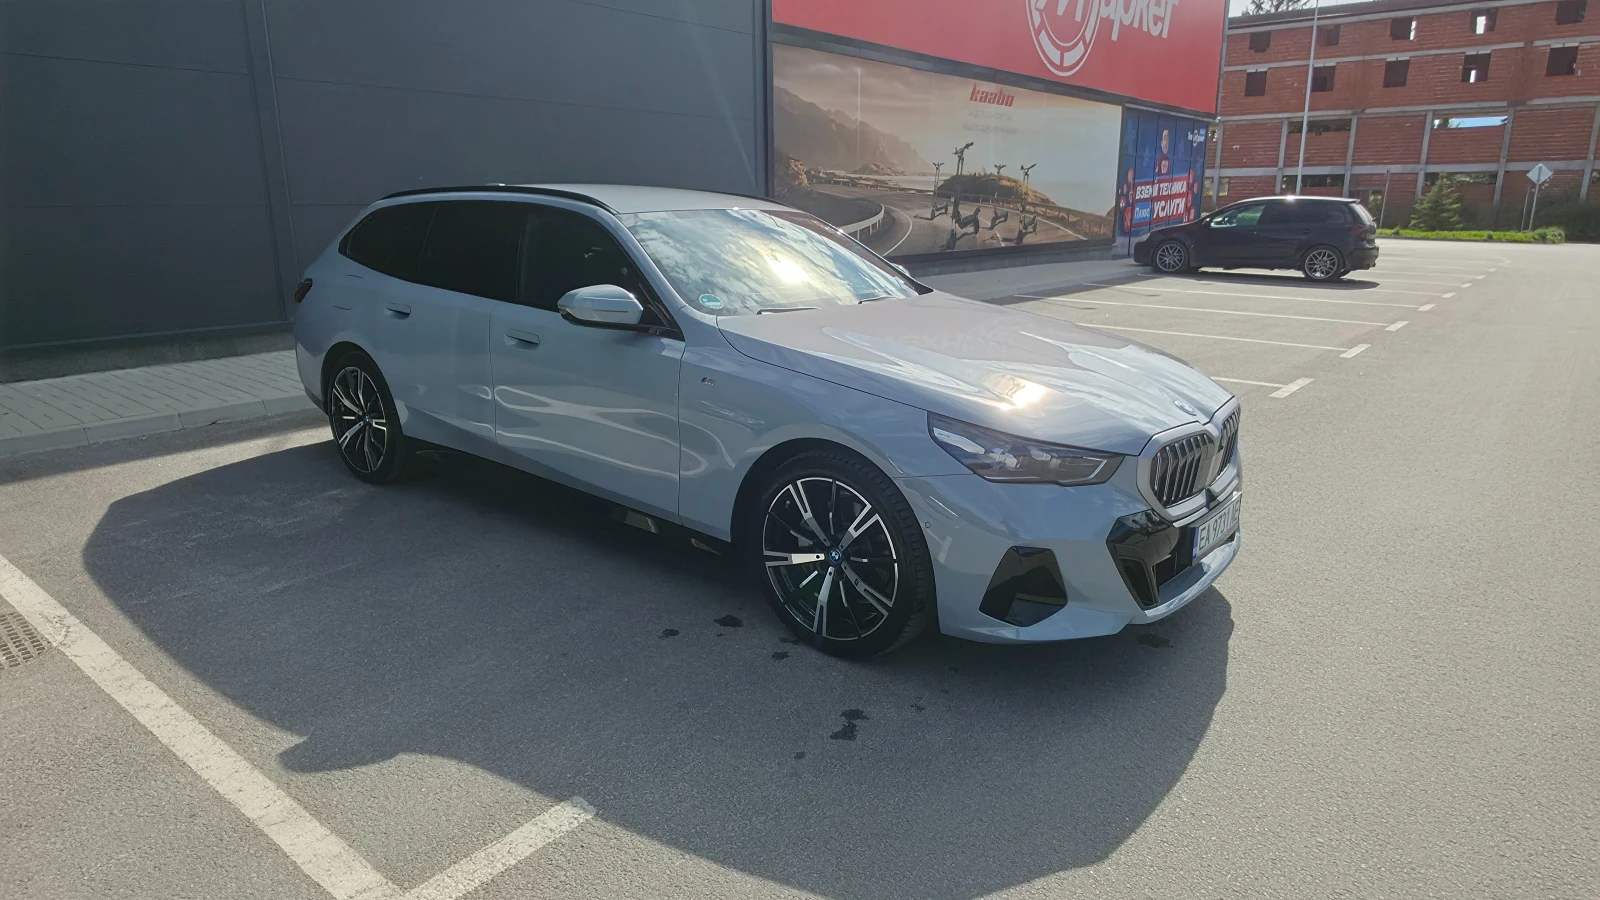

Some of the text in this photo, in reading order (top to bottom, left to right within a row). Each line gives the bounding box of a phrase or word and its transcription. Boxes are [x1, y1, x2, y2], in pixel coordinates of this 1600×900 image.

[969, 82, 1014, 107] kaabo
[1160, 181, 1186, 195] ТЕХНИКА
[1153, 198, 1185, 218] УСЛУГИ
[1199, 524, 1210, 551] EA
